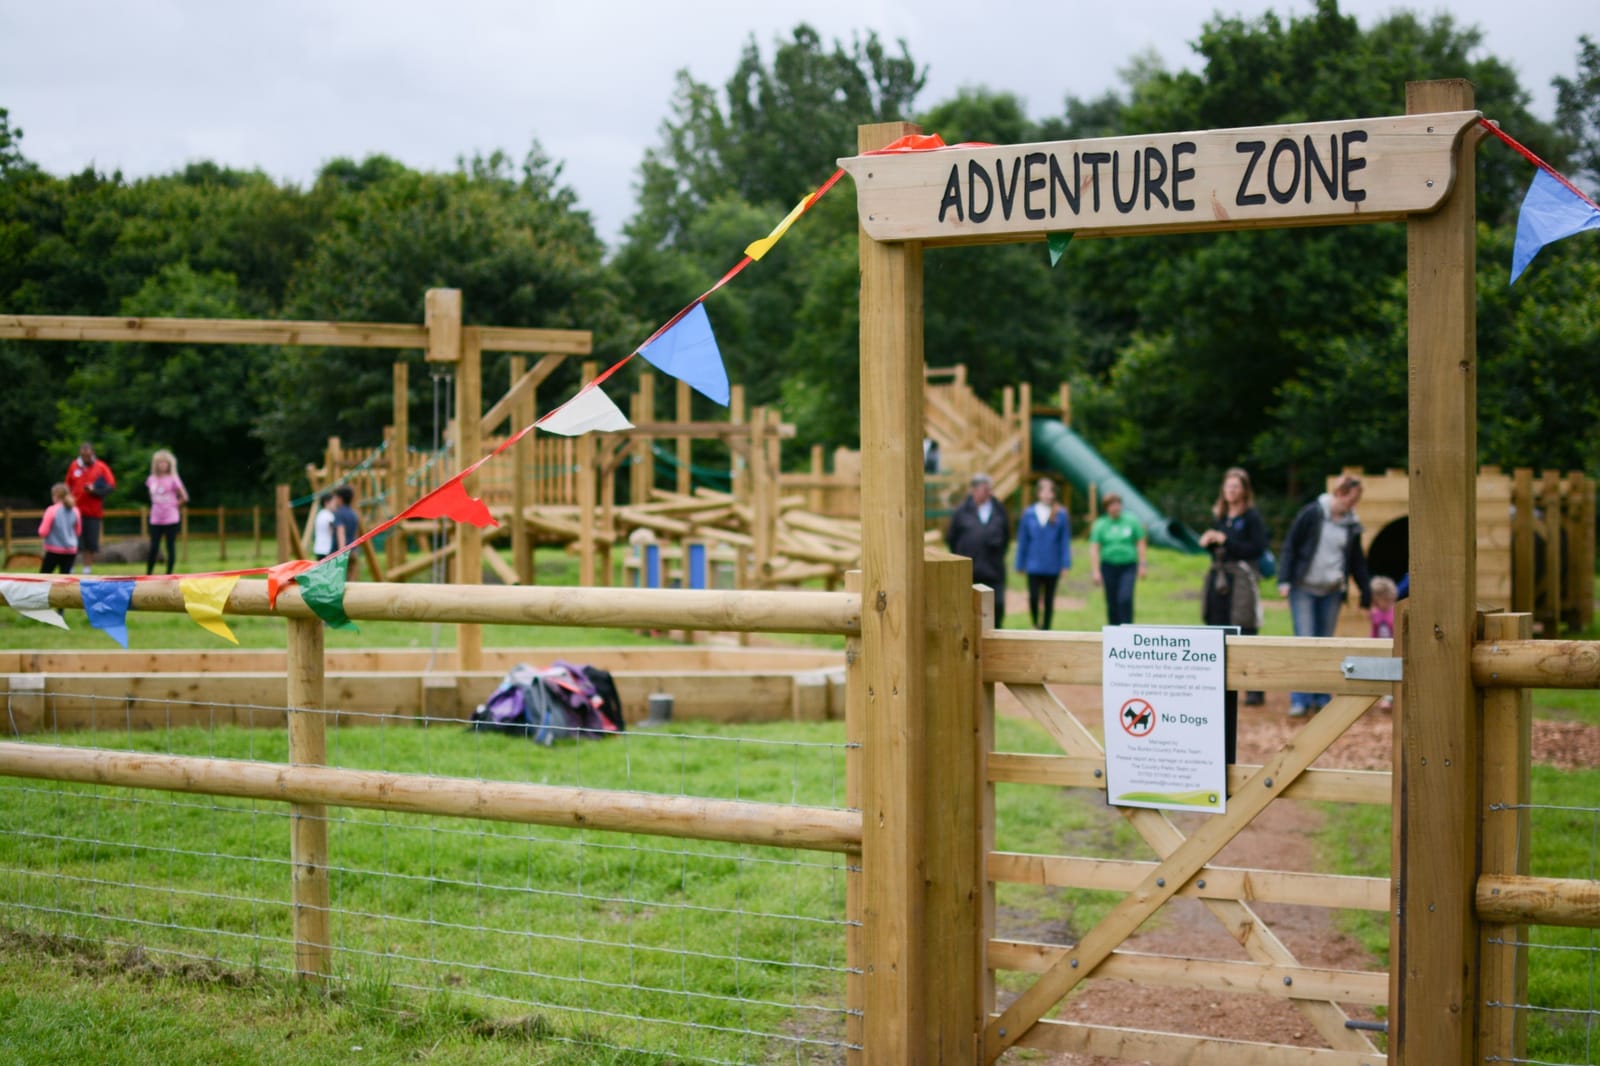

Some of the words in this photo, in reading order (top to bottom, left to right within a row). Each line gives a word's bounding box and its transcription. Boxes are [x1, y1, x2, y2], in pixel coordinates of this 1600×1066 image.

[938, 141, 1196, 224] ADVENTURE
[1236, 130, 1369, 207] ZONE
[1133, 634, 1191, 648] Denham
[1109, 647, 1178, 661] Adventure
[1181, 650, 1217, 662] Zone
[1161, 713, 1177, 724] No
[1180, 714, 1208, 727] Dogs
